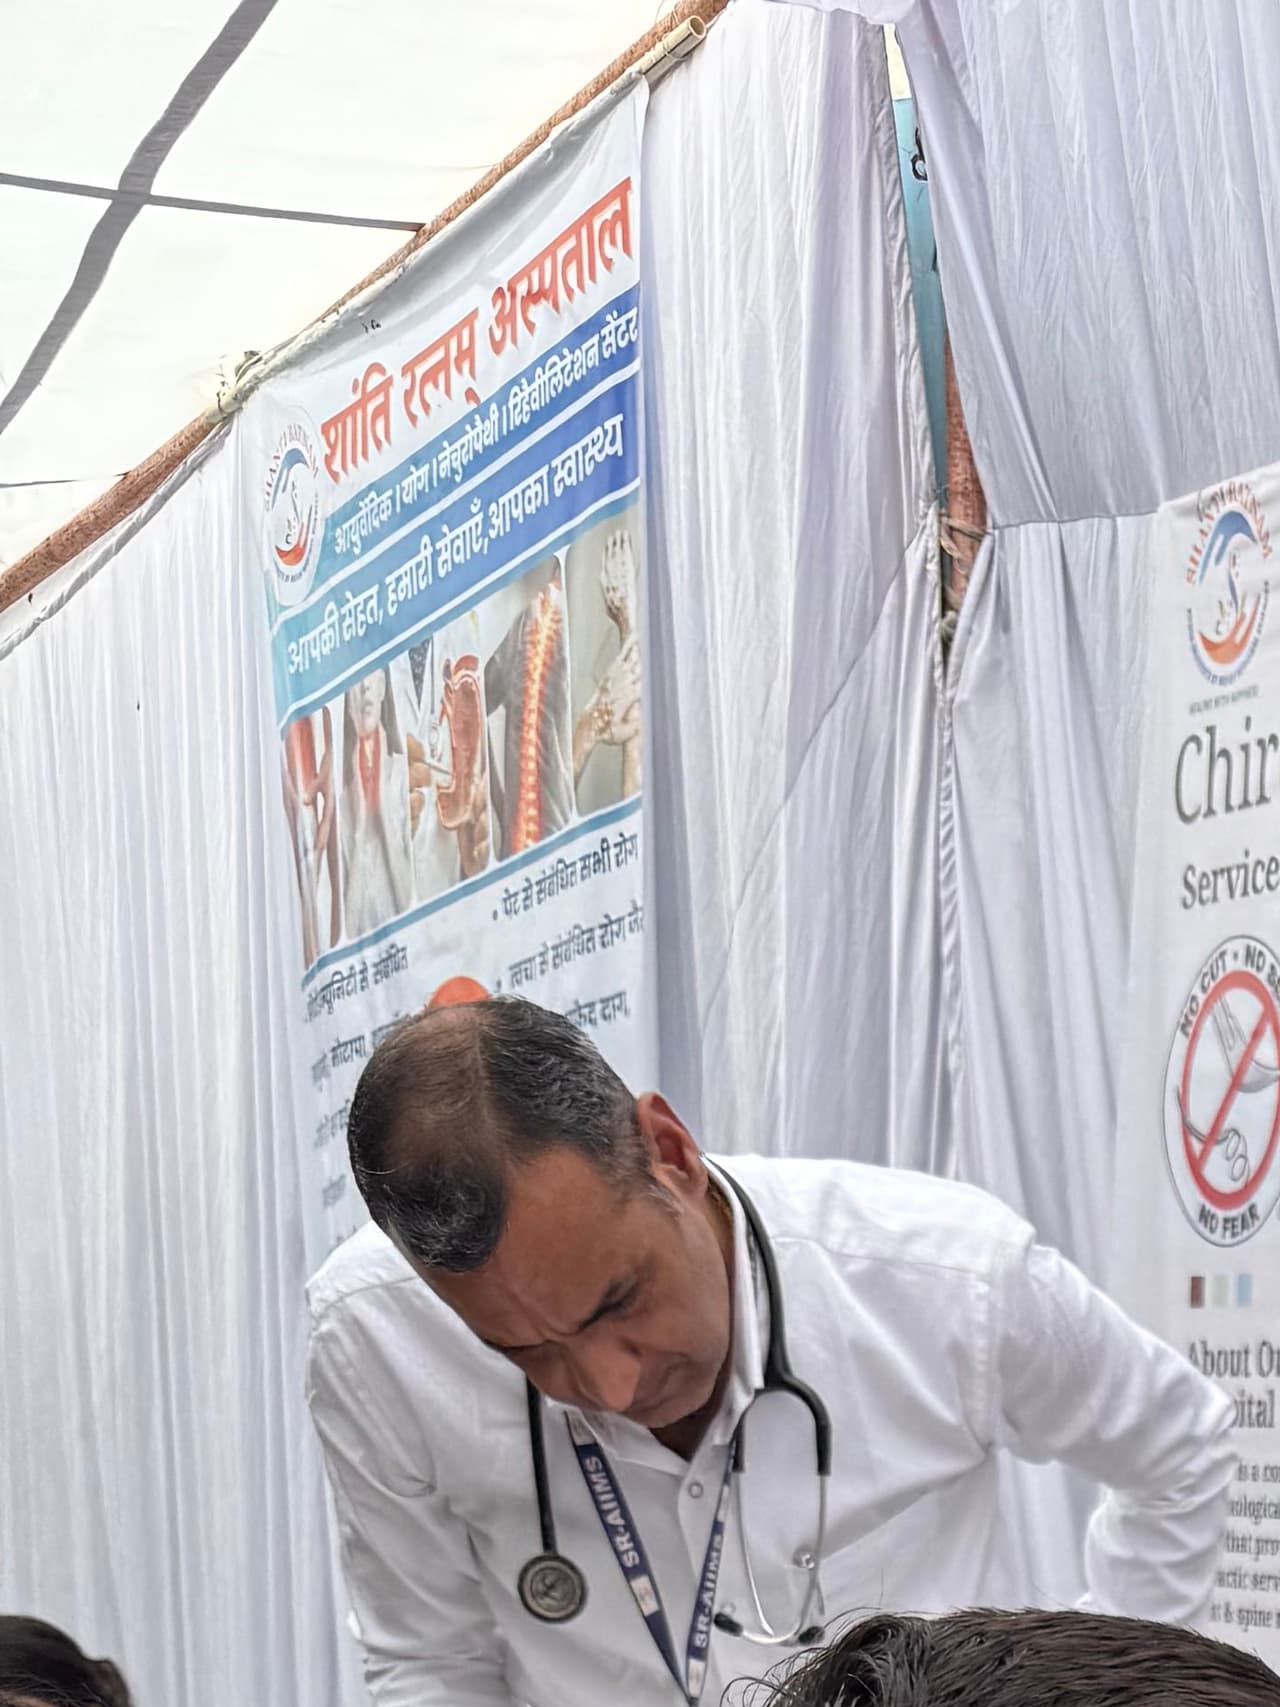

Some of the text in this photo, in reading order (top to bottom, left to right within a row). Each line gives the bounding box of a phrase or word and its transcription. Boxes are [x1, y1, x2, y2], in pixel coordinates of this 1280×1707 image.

[321, 176, 632, 484] शांति रत्नम् अस्पताल
[402, 465, 429, 502] योग
[600, 304, 639, 363] सेंटर
[287, 608, 340, 676] आपकी
[341, 591, 385, 647] सेहत,
[386, 535, 433, 620] हमारी
[488, 466, 549, 535] आपका
[552, 412, 625, 500] स्वास्थ्य
[1200, 949, 1228, 992] CUT
[1199, 1203, 1260, 1240] NO FEAR
[585, 1456, 640, 1569] SR-AIIMS
[1237, 1605, 1272, 1632] spine
